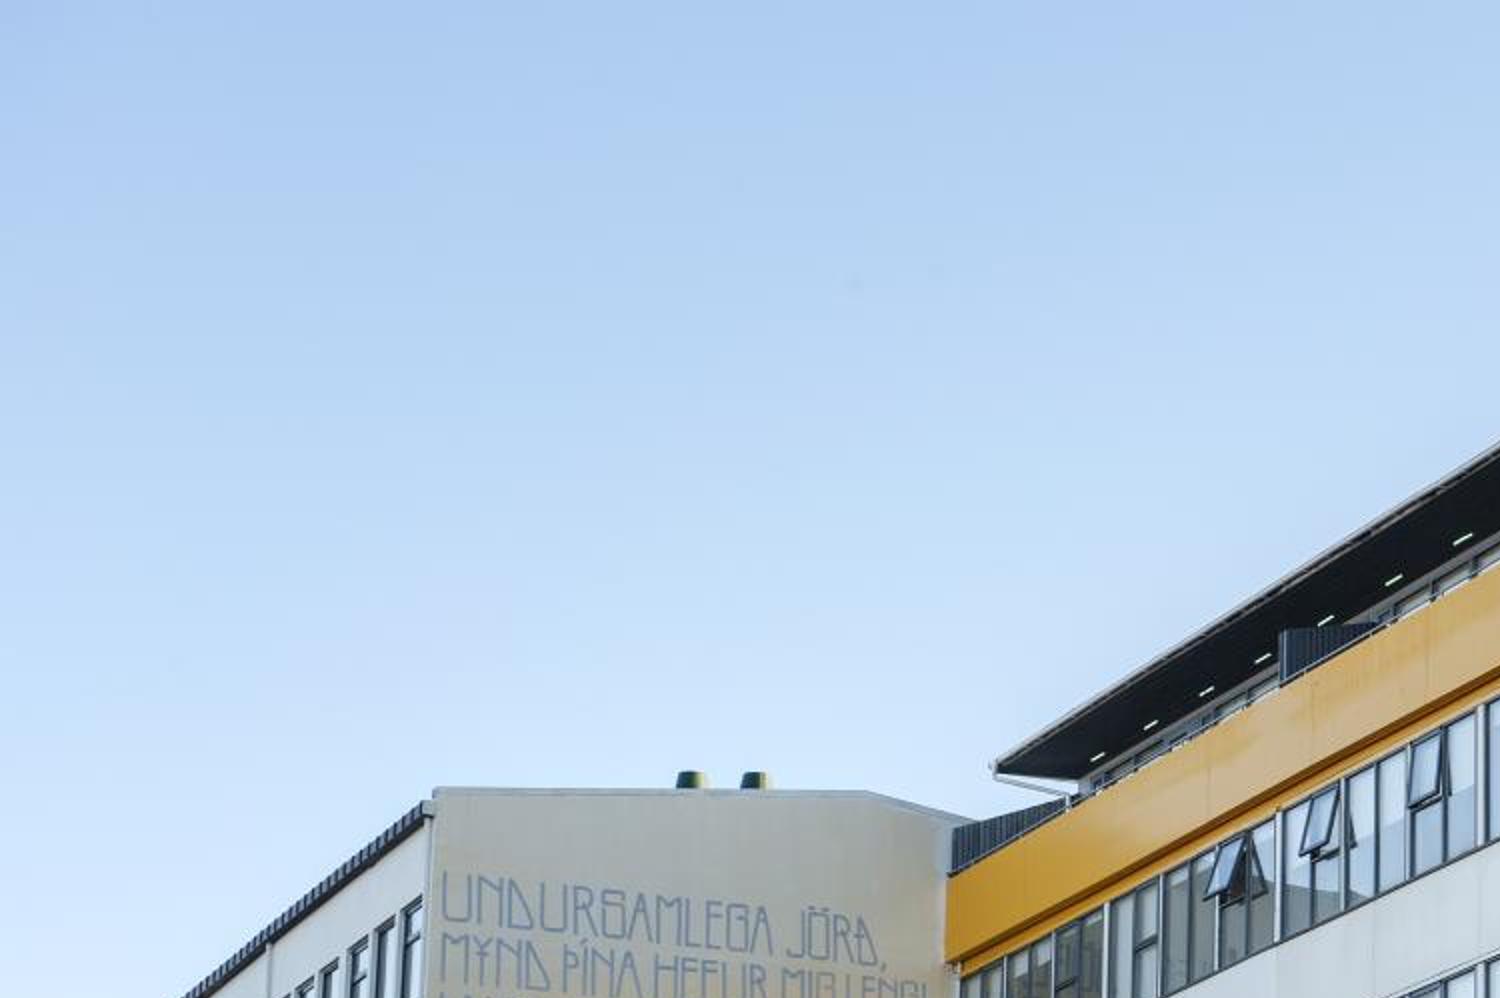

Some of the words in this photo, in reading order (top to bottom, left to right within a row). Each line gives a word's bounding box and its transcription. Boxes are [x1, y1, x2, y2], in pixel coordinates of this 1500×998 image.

[440, 931, 551, 993] MYND
[442, 870, 774, 957] UNDURSAMLEGA
[786, 905, 887, 972] JÖRÐ,
